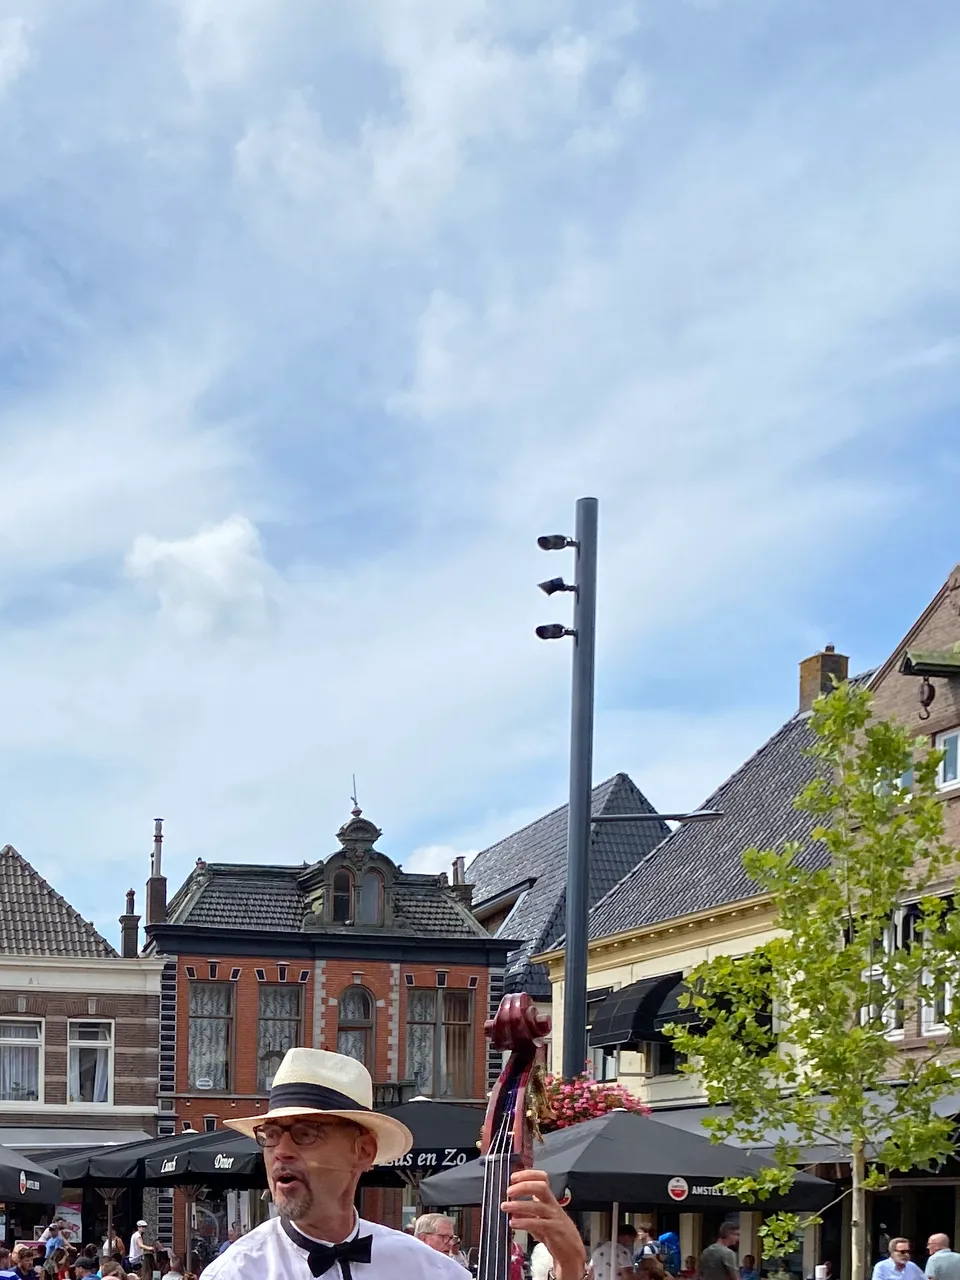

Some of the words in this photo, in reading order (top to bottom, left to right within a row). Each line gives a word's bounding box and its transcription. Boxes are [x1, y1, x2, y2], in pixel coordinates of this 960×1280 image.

[417, 1153, 437, 1166] en
[442, 1148, 467, 1166] Zo
[691, 1186, 721, 1196] AMSTEL
